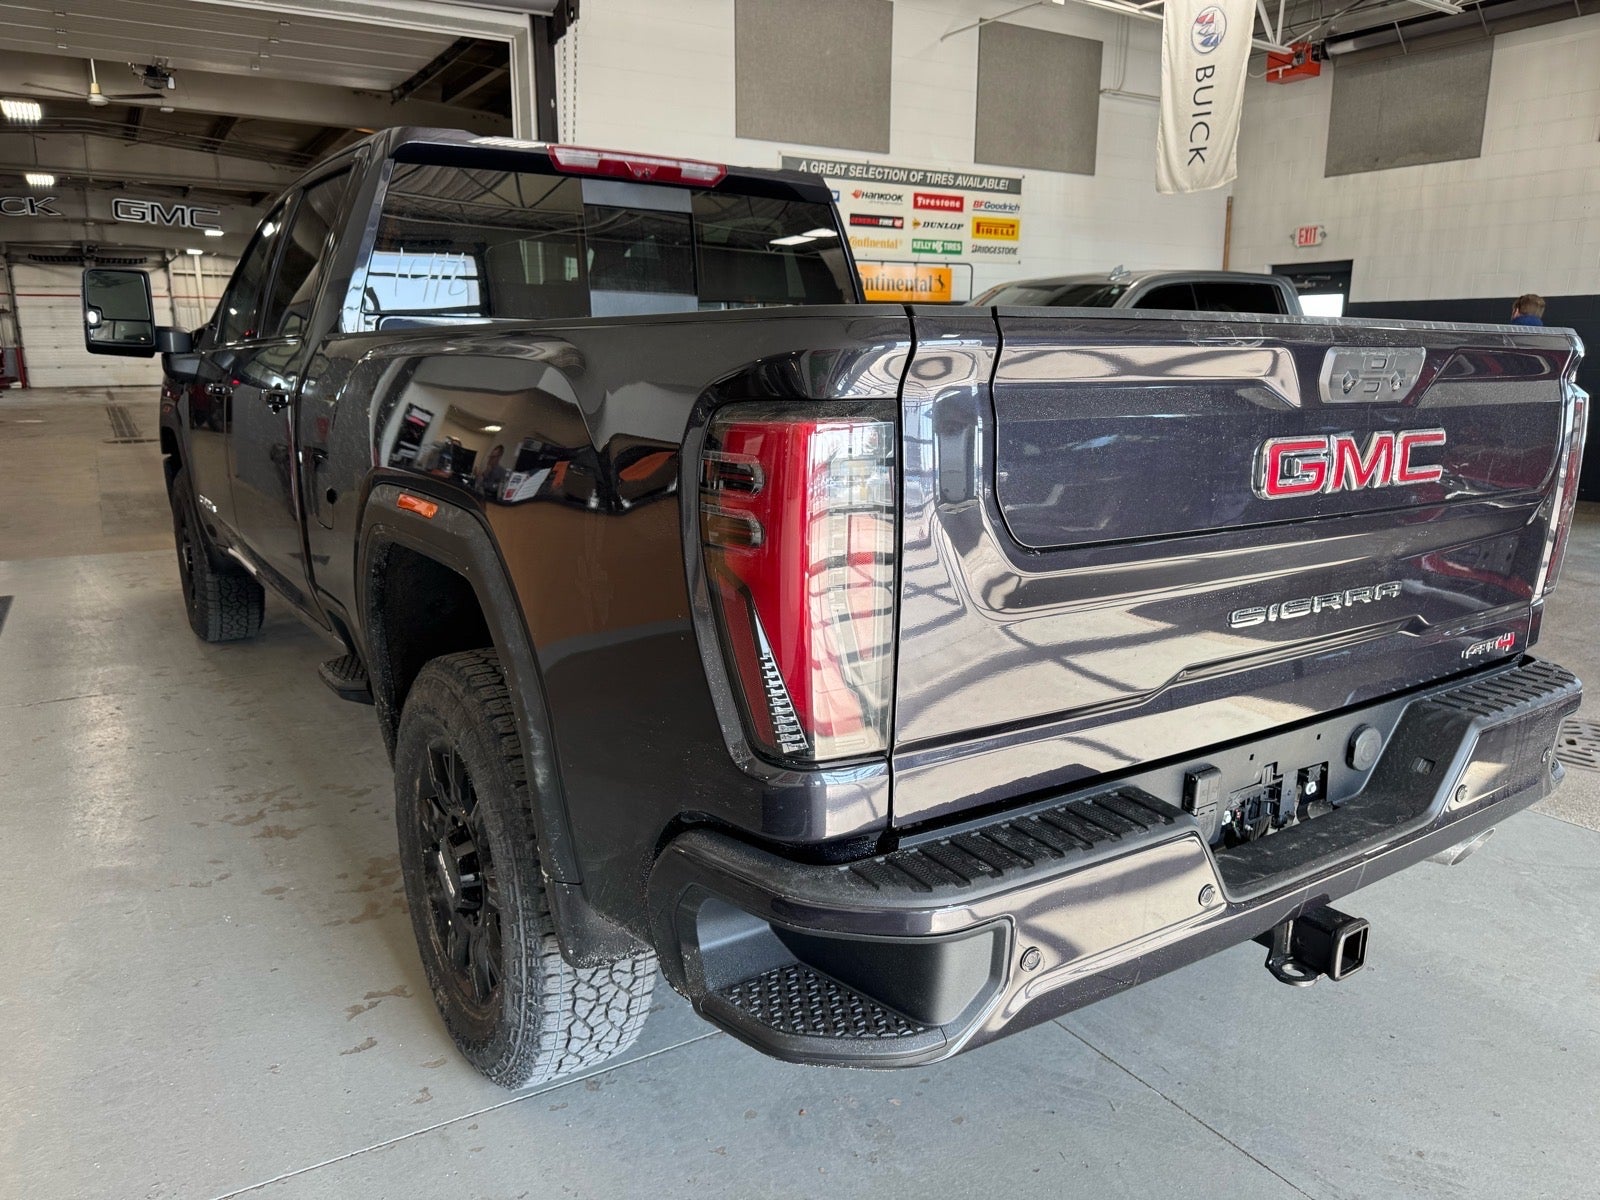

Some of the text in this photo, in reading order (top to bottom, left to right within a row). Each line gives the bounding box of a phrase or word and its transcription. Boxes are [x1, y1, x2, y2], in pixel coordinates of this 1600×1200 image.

[1187, 65, 1215, 166] BUICK
[799, 160, 1009, 190] A GREAT SELECTION OF TIRES AVAILABLE!
[112, 198, 220, 230] GMC
[916, 196, 961, 209] Firestone
[922, 221, 964, 231] DUNLOP
[976, 221, 1015, 237] PIRELLI
[1298, 226, 1318, 245] EXIT
[912, 240, 931, 249] KELLY
[971, 244, 1018, 256] BRIDGESTONE
[1252, 427, 1447, 500] GMC
[1227, 580, 1403, 629] SIERRA
[1461, 631, 1516, 659] AT4
